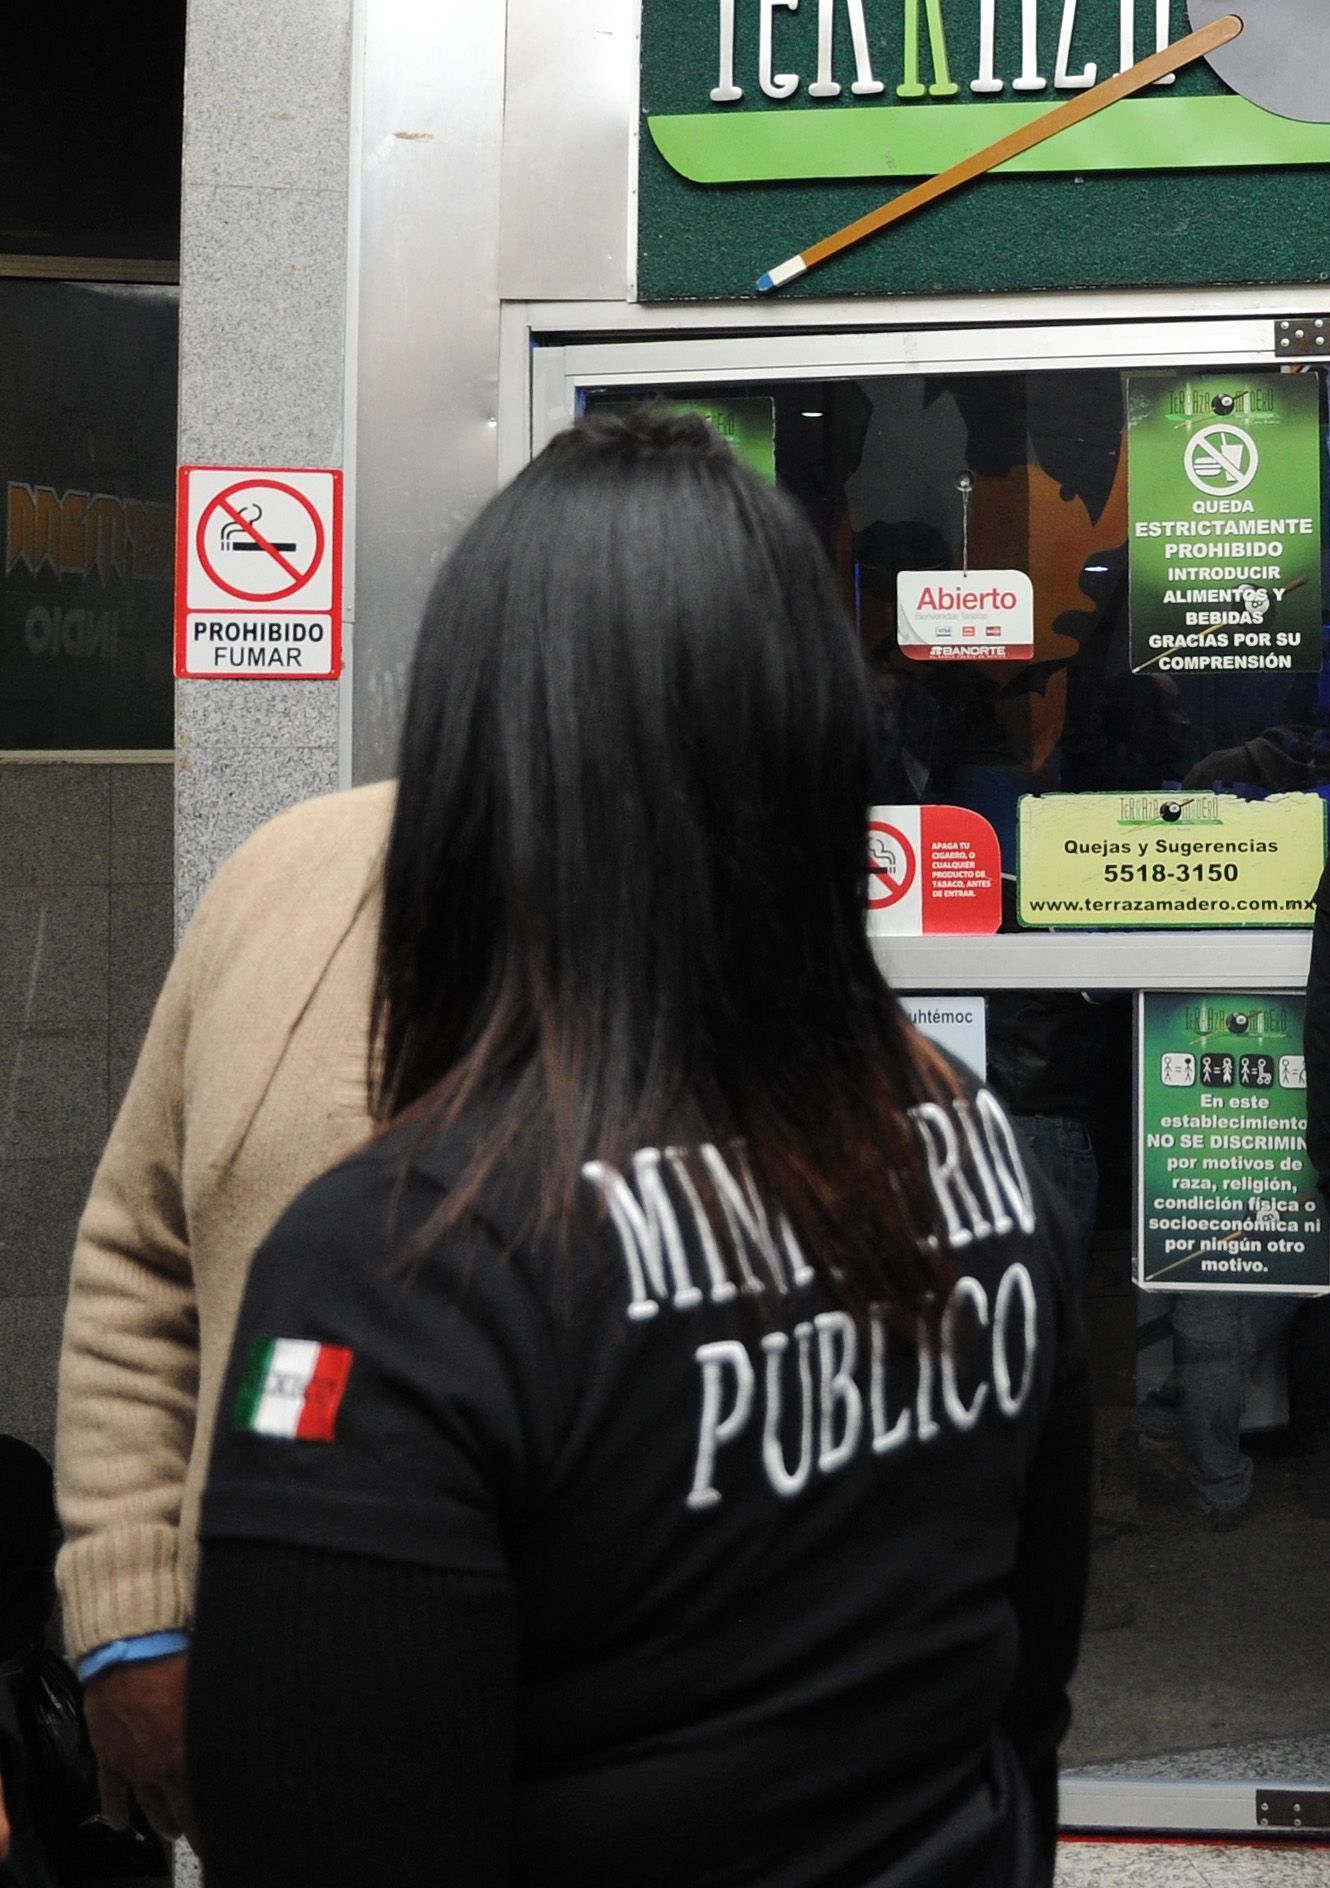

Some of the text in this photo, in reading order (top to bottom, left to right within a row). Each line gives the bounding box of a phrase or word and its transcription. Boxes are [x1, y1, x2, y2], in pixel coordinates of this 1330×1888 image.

[1192, 499, 1254, 514] QUEDA
[1135, 518, 1312, 537] ESTRICTAMENTE
[1164, 541, 1283, 559] PROHIBIDO
[1168, 565, 1280, 581] INTRODUCIR
[916, 586, 1017, 610] Abierto
[1163, 587, 1287, 603] ALIMENTOS Y
[1185, 611, 1264, 625] BEBIDAS
[194, 621, 324, 642] PROHIBIDO
[1149, 632, 1301, 648] GRACIAS POR SU
[214, 646, 302, 667] FUMAR
[943, 646, 1006, 656] BANORTE
[1158, 652, 1292, 670] COMPRENSIÓN
[1064, 839, 1279, 857] Quejas y Sugerencias
[1104, 863, 1239, 883] 5518-3150
[1029, 897, 1316, 912] www.terrazamadero.com.mx
[1201, 1093, 1269, 1109] En este
[1161, 1115, 1307, 1130] establecimiento
[1147, 1134, 1174, 1148] NO
[1180, 1134, 1204, 1148] SE
[1167, 1156, 1303, 1171] por motivos de
[1172, 1176, 1298, 1194] raza, religión,
[1154, 1196, 1316, 1212] condición física o
[1149, 1216, 1321, 1232] socioeconómica ni
[1165, 1236, 1305, 1255] por ningún otro
[1201, 1257, 1269, 1273] motivo.
[686, 1261, 1037, 1510] PUBLICO
